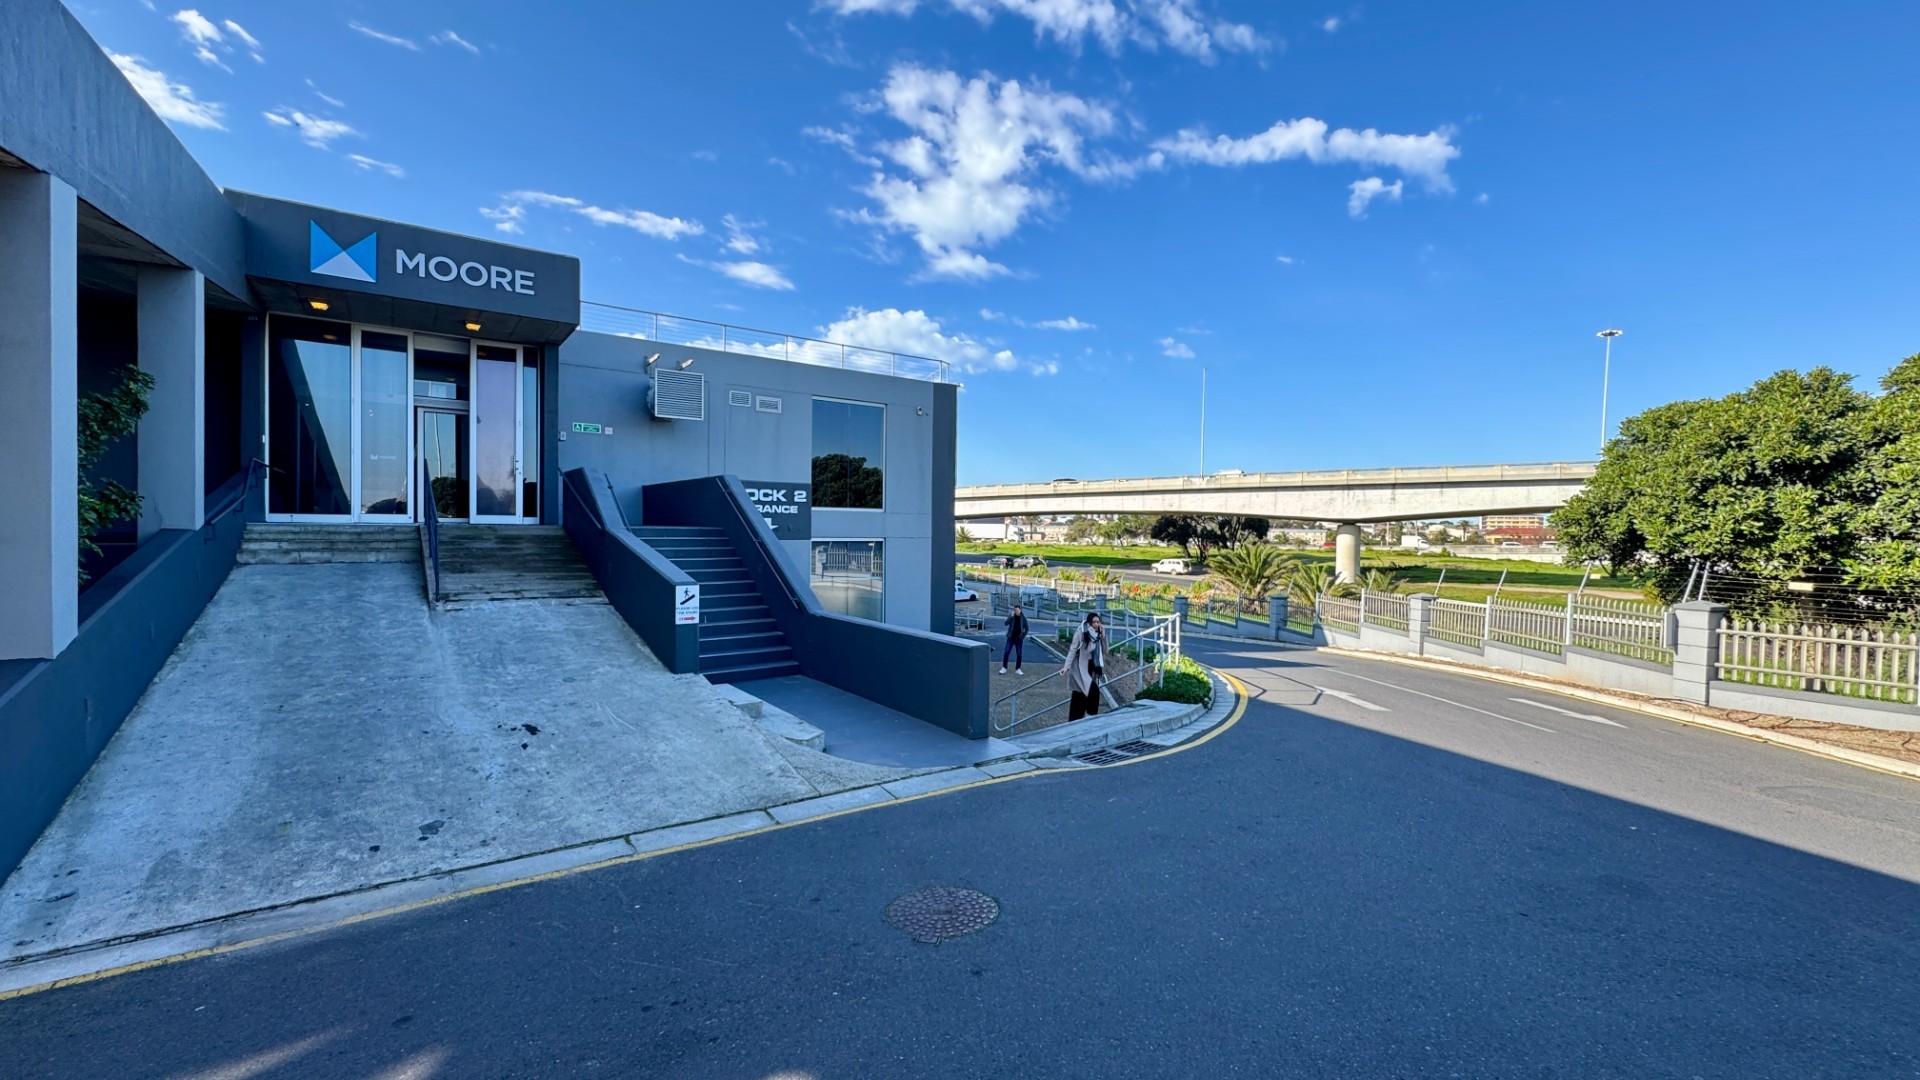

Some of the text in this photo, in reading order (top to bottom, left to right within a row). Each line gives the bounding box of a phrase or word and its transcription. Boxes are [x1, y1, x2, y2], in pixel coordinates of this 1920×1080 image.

[396, 249, 535, 295] MOORE
[745, 488, 808, 503] OCK 2
[755, 505, 799, 514] RANCE
